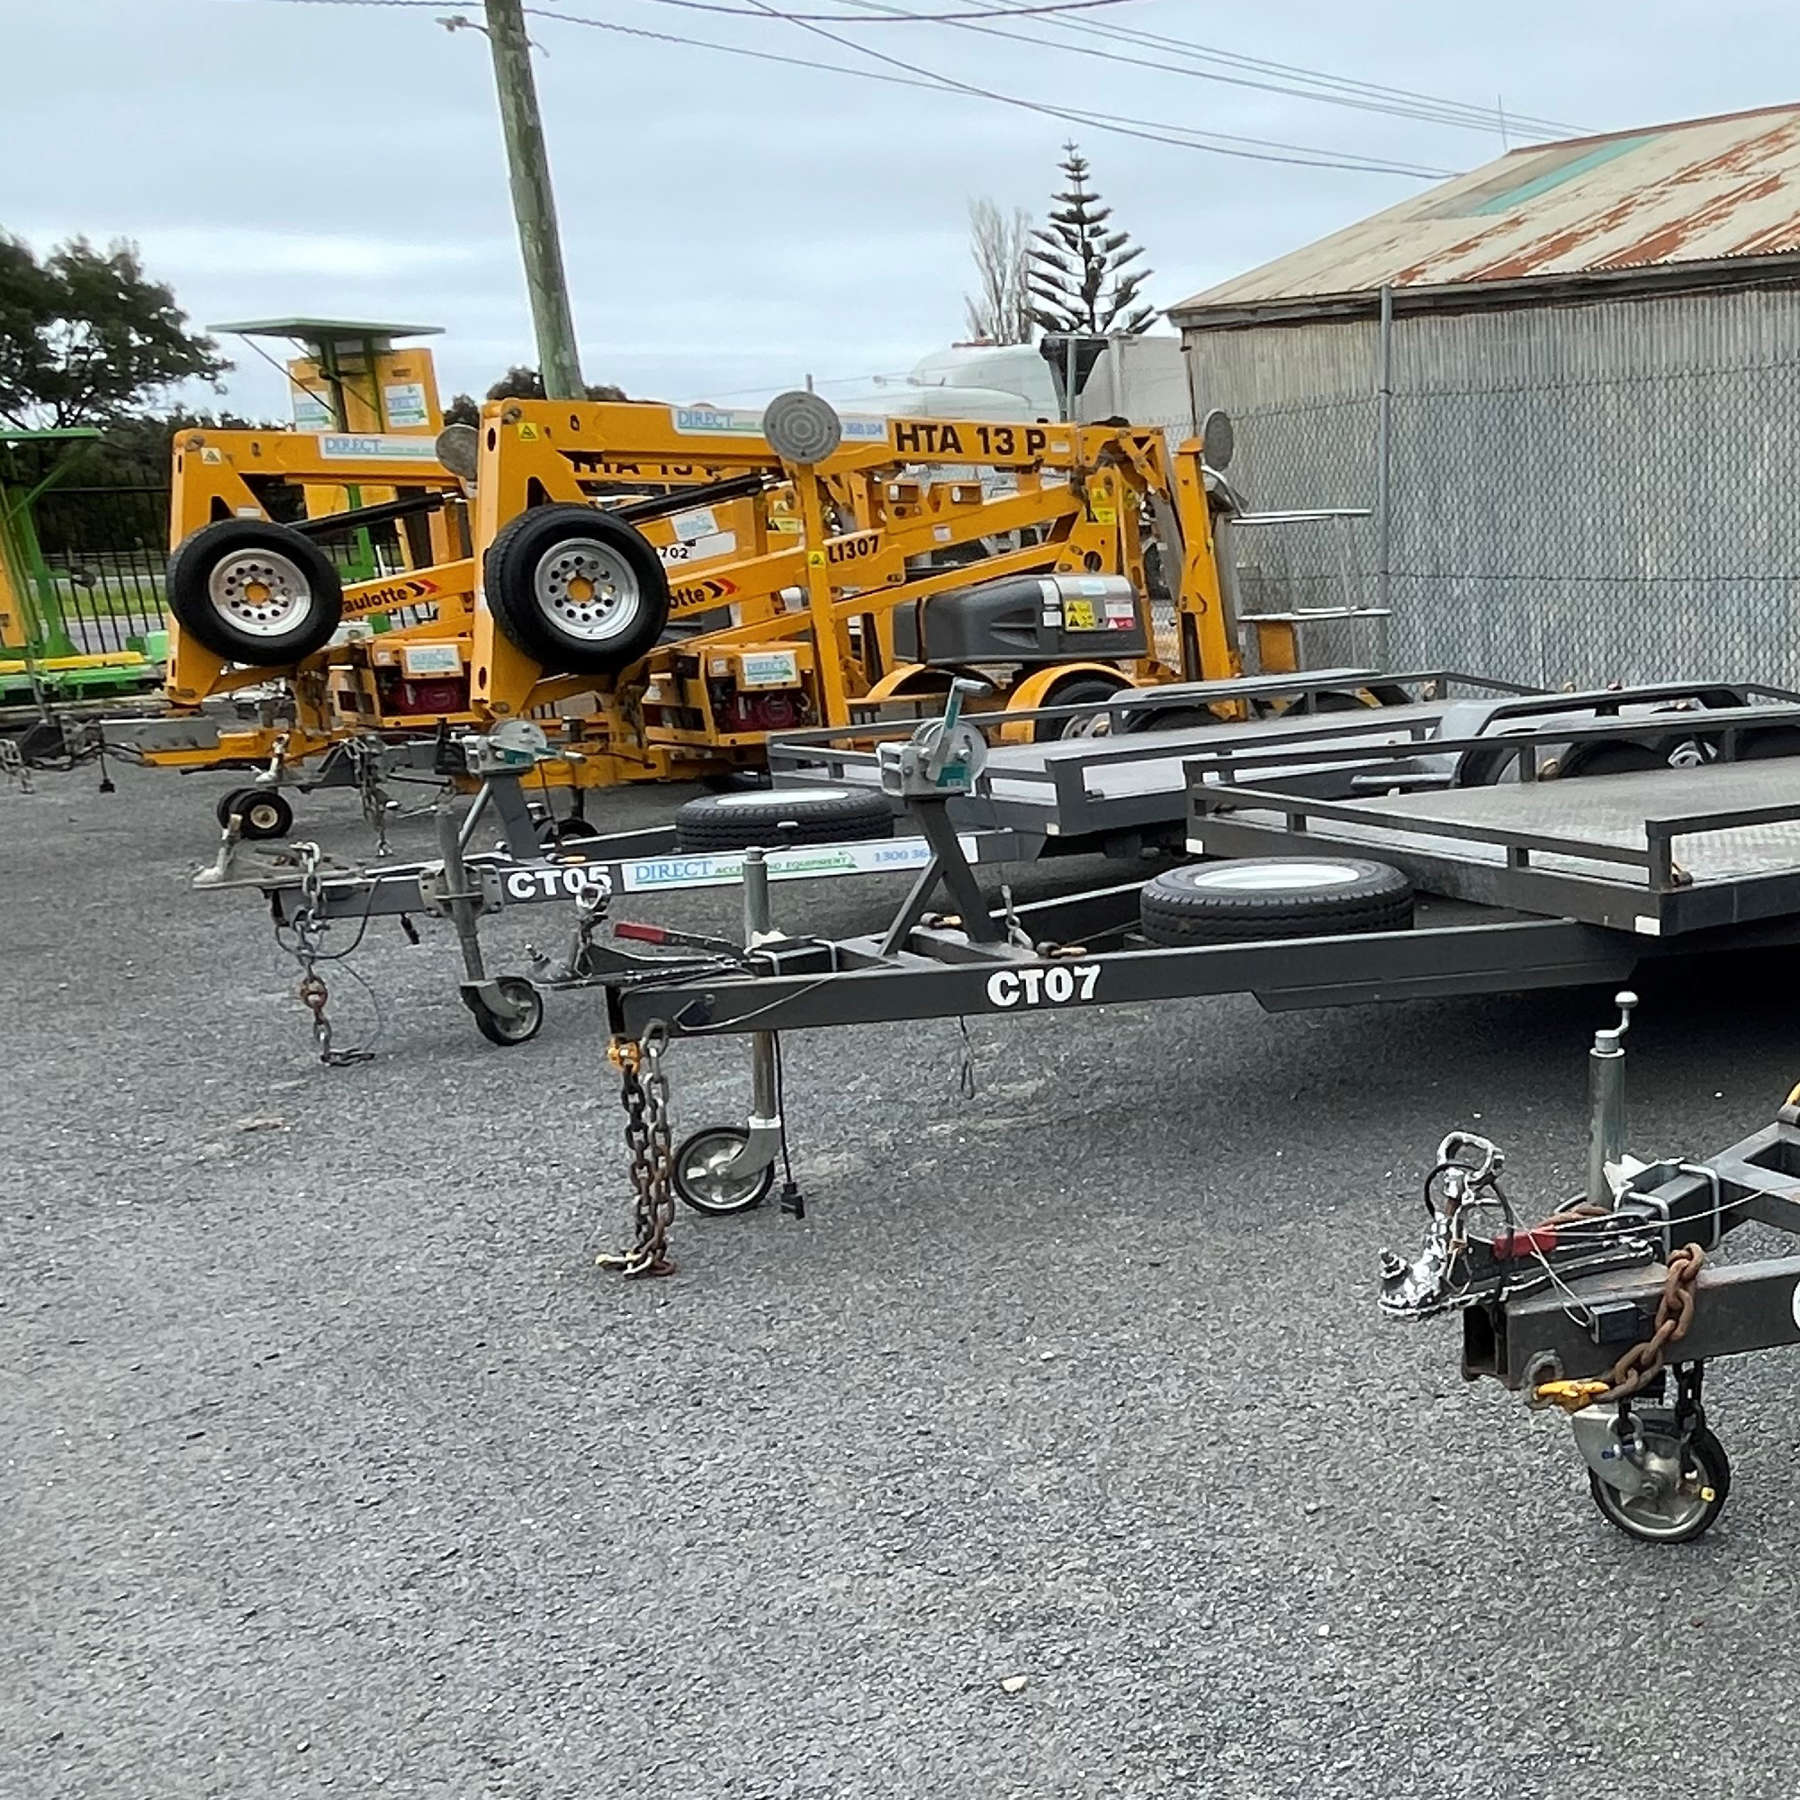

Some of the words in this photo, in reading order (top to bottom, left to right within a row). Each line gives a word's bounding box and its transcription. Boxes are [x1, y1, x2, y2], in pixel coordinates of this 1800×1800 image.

[678, 410, 734, 427] DIRECT
[324, 437, 382, 453] DIRECT
[895, 422, 963, 454] HTA
[976, 427, 1014, 456] 13
[1026, 429, 1046, 456] P
[660, 546, 689, 559] 702
[342, 587, 408, 612] aulotte
[669, 587, 705, 609] otte
[634, 861, 713, 881] DIRECT
[715, 865, 743, 875] ACCE
[875, 850, 908, 862] 1300
[911, 850, 929, 861] 36
[507, 866, 612, 898] CT05
[987, 964, 1100, 1007] CT07
